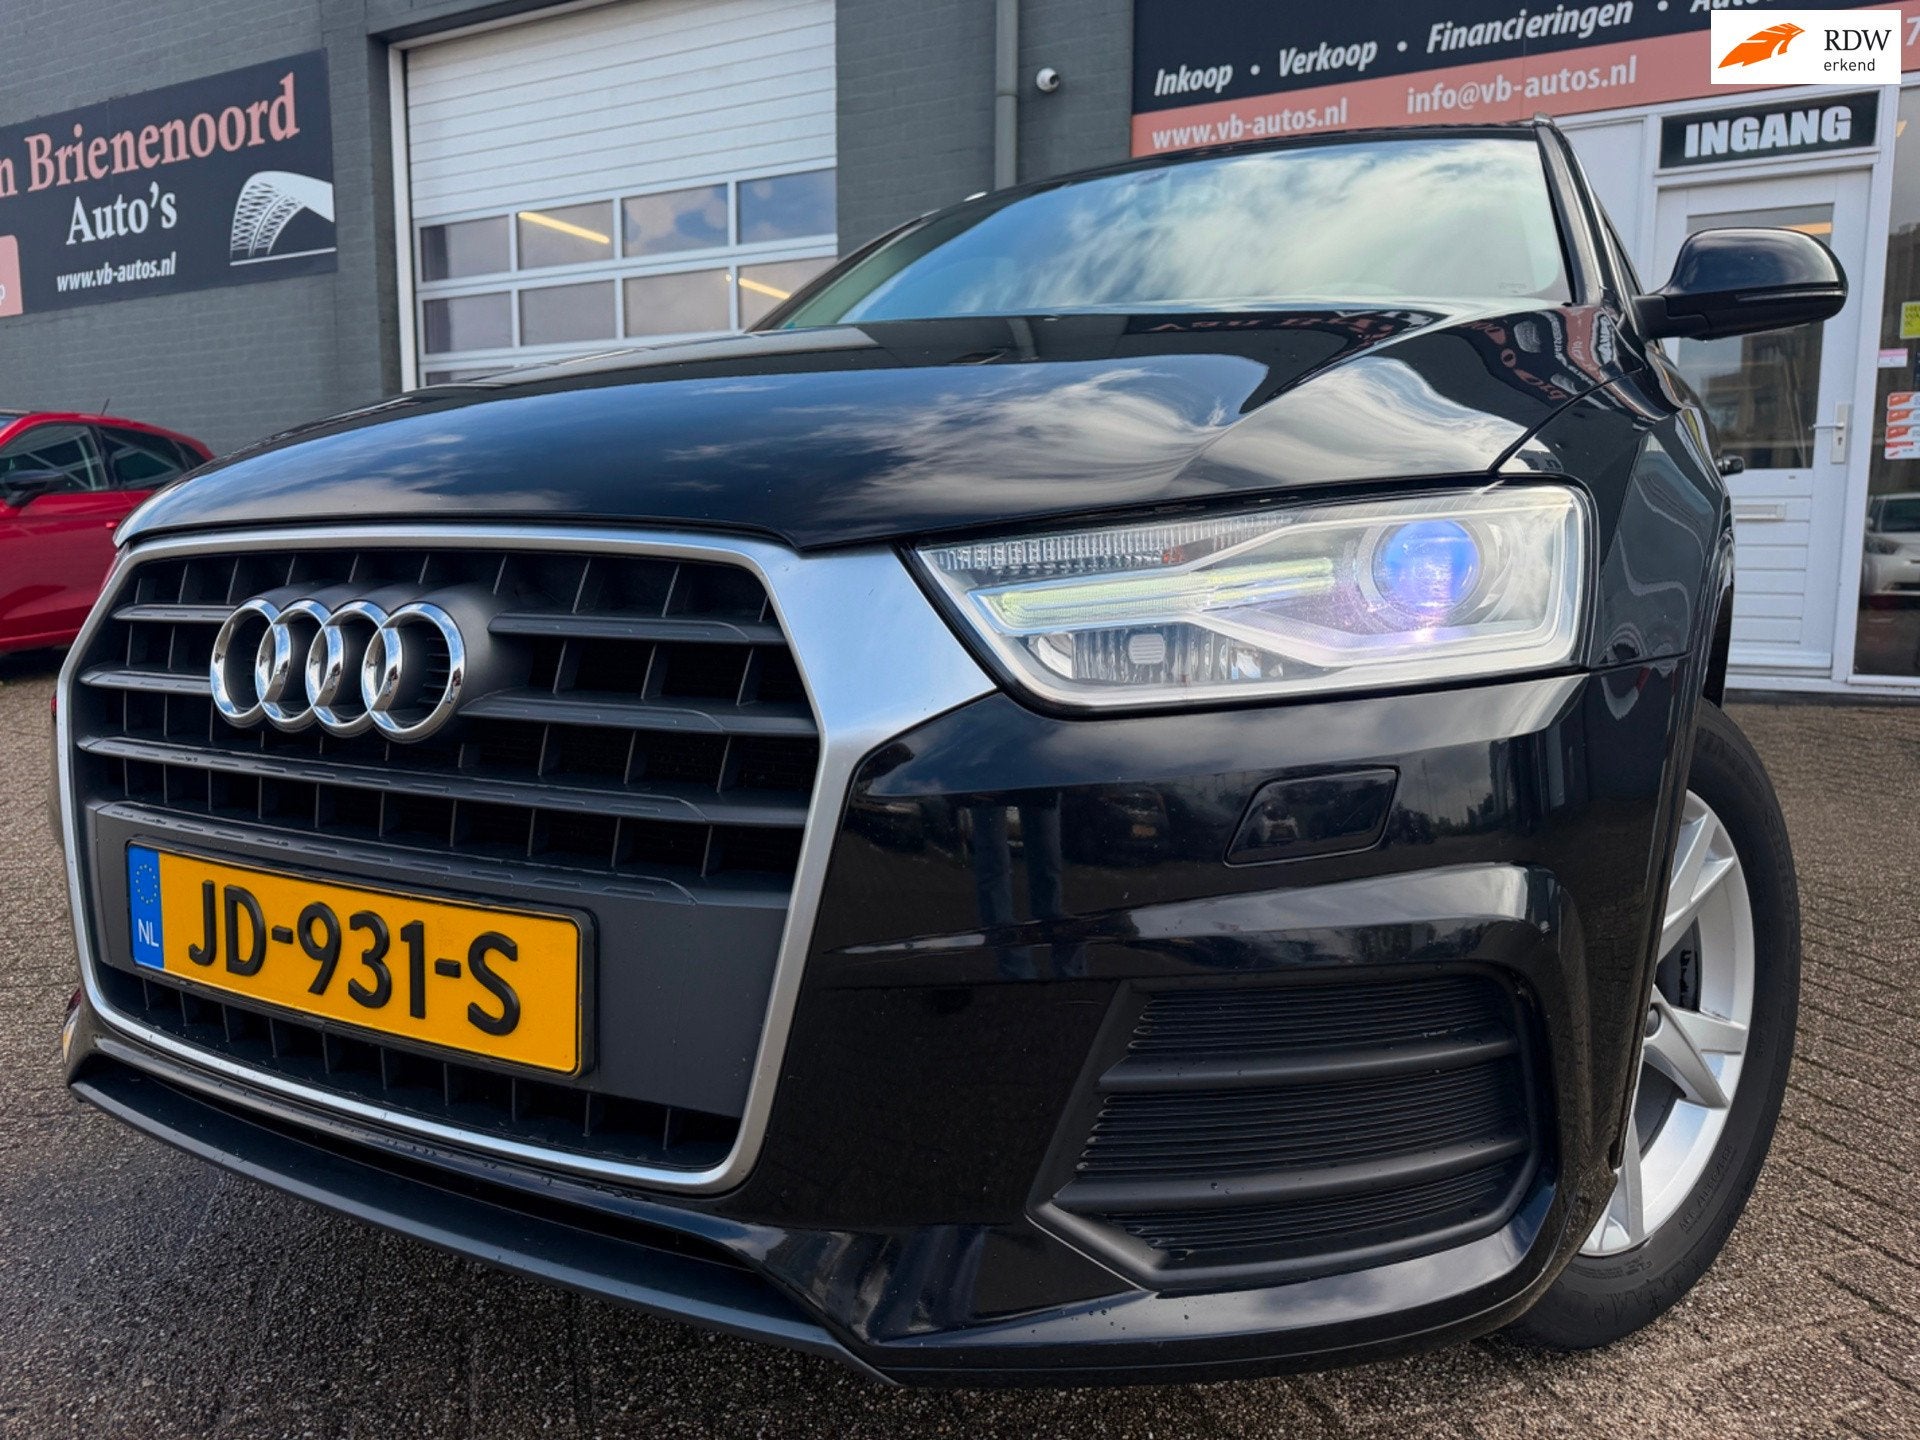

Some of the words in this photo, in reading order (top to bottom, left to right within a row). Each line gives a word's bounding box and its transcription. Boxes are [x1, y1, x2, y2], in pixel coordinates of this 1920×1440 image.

[1154, 64, 1233, 97] Inkoop
[1278, 40, 1378, 78] Verkoop
[1426, 1, 1634, 54] Financieringen
[24, 71, 300, 193] Brienenoord
[1152, 97, 1348, 150] www.vb-autos.nl
[1406, 55, 1637, 115] info@vb-autos.nl
[1684, 105, 1853, 159] INGANG
[66, 180, 178, 246] Auto's
[56, 250, 178, 293] www.vb-autos.nl
[137, 917, 160, 949] NL
[187, 879, 522, 1037] JD-931-S
